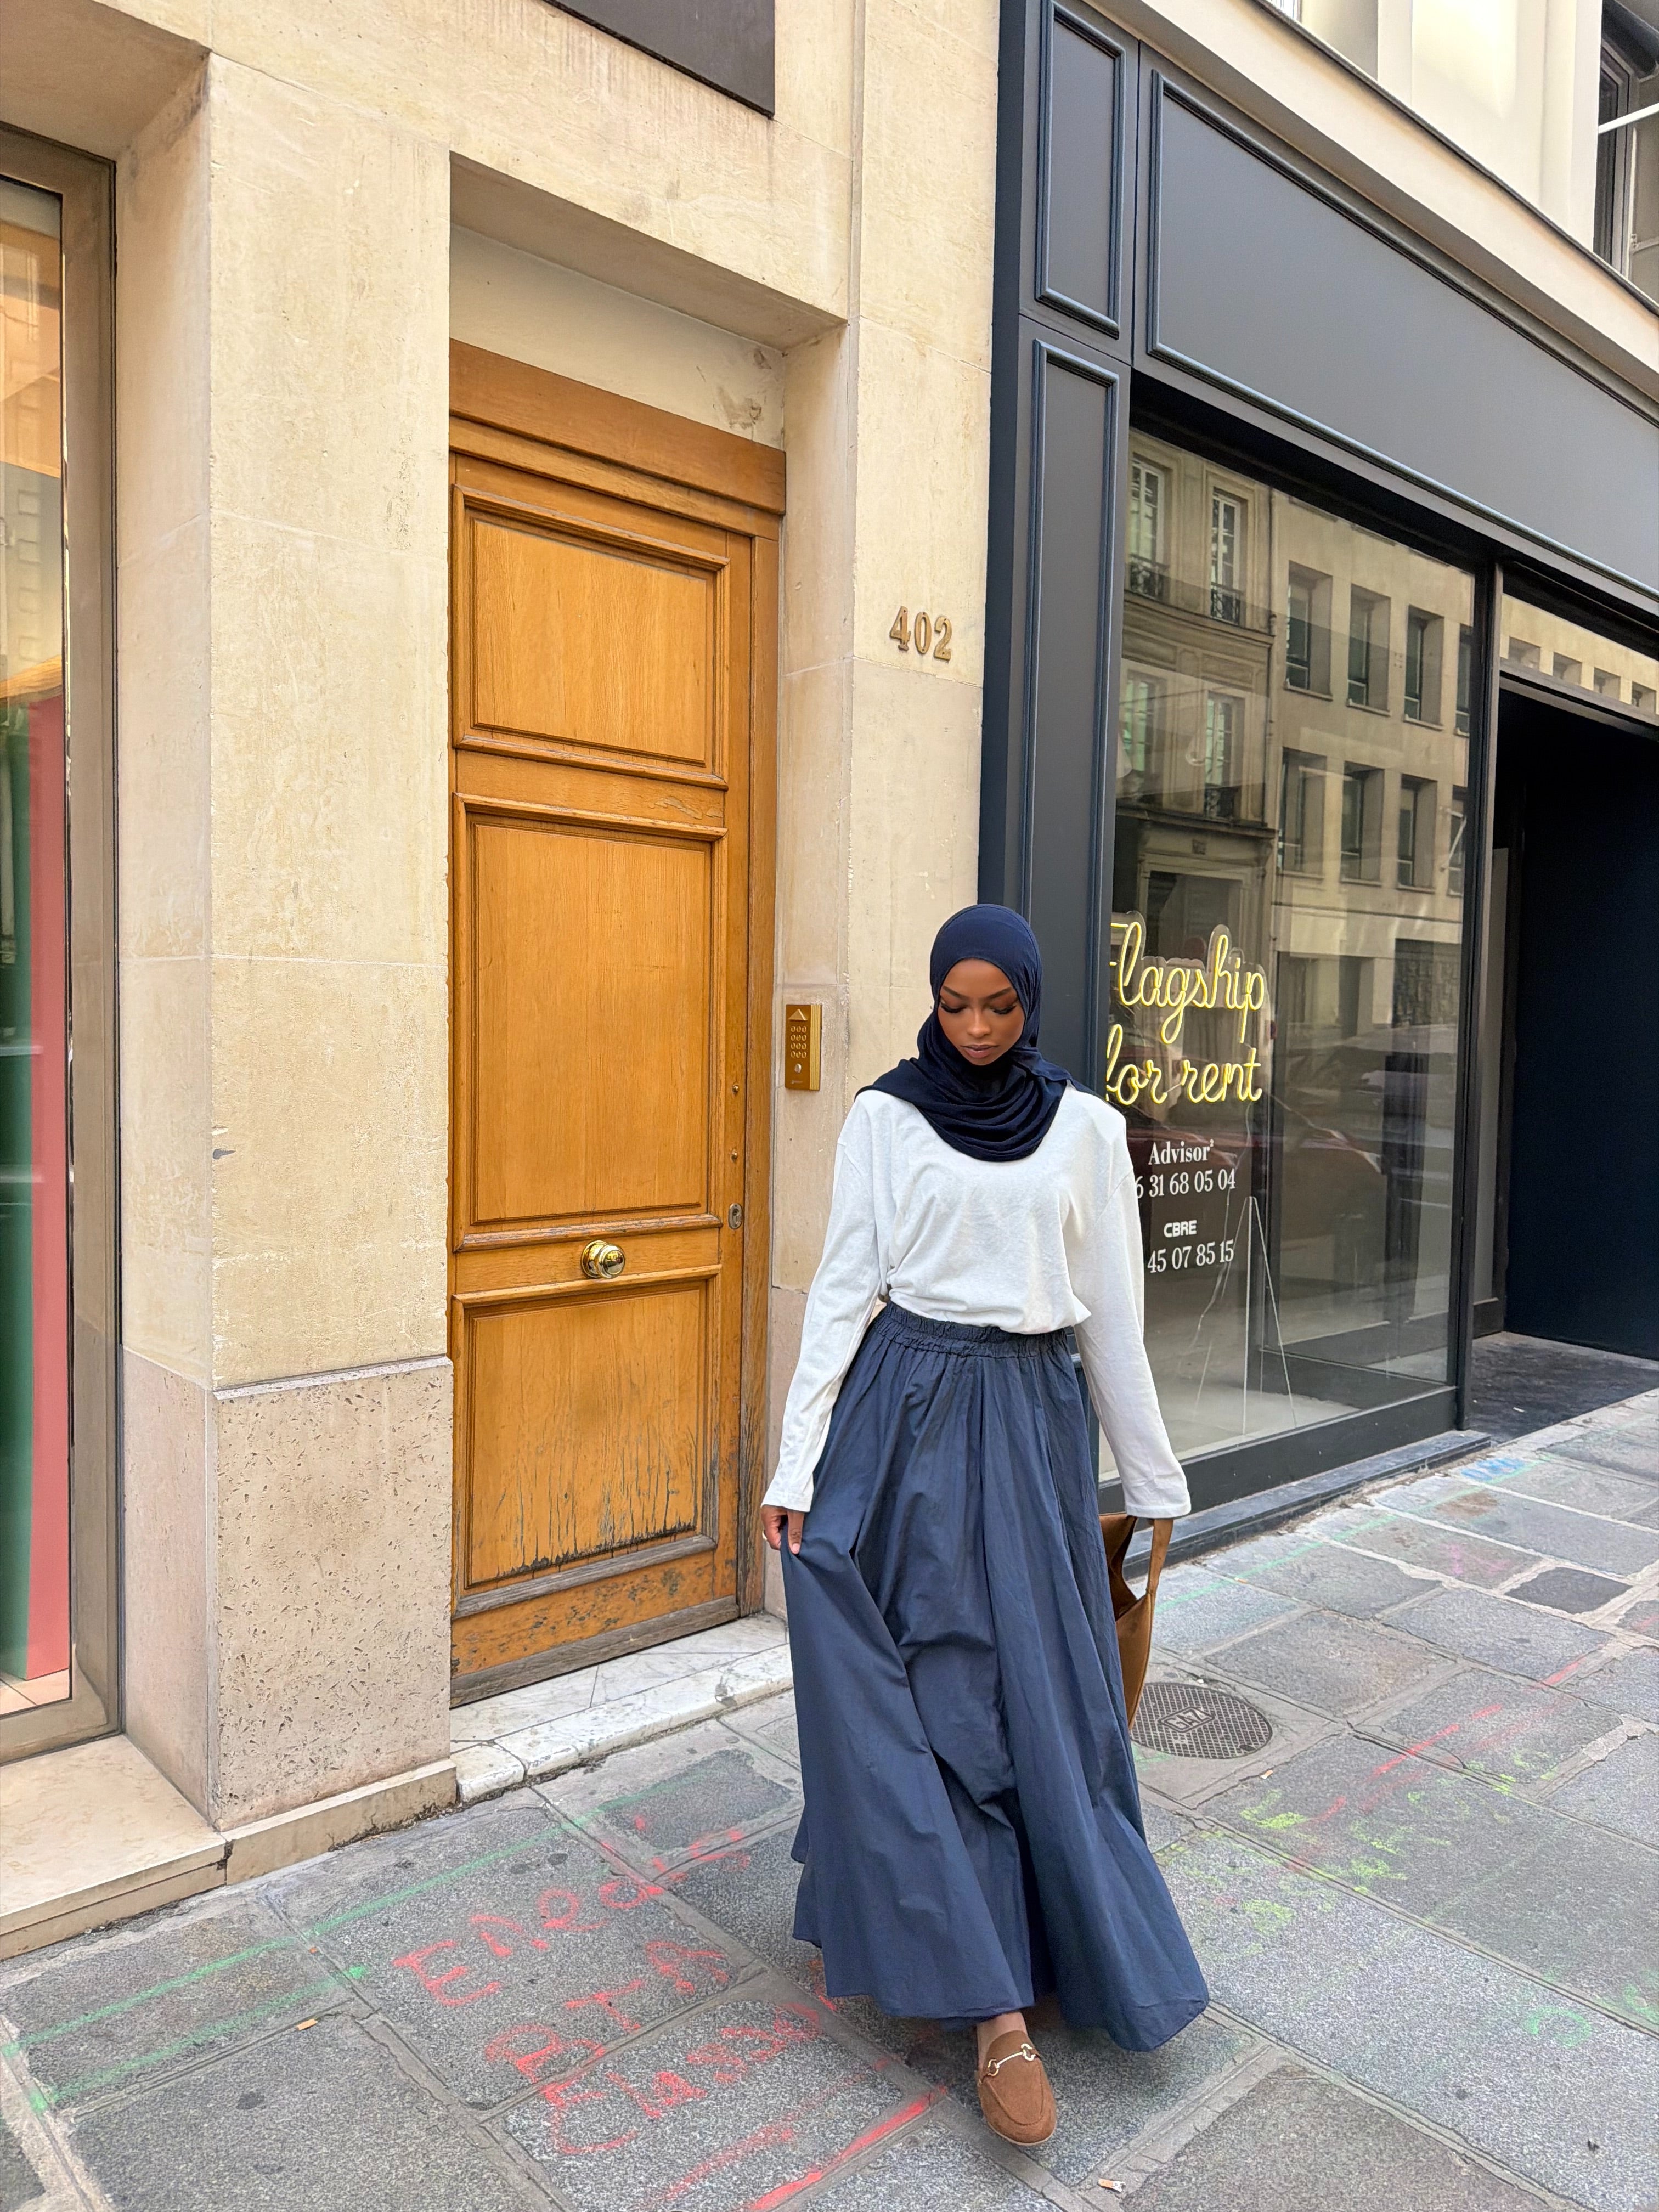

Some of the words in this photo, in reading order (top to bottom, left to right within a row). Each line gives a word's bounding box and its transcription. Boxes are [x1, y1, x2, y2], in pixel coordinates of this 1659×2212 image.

[889, 606, 952, 662] 402
[1181, 1047, 1262, 1103] rent
[1149, 1174, 1164, 1197] 31
[1170, 1172, 1189, 1195] 68
[1194, 1169, 1213, 1192] 05
[1218, 1168, 1235, 1190] 04
[1164, 1220, 1197, 1238] CBRE
[1148, 1248, 1166, 1273] 45
[1172, 1246, 1192, 1270] 07
[1196, 1241, 1215, 1266] 85
[1220, 1239, 1234, 1263] 15
[1163, 1709, 1210, 1730] GAZ
